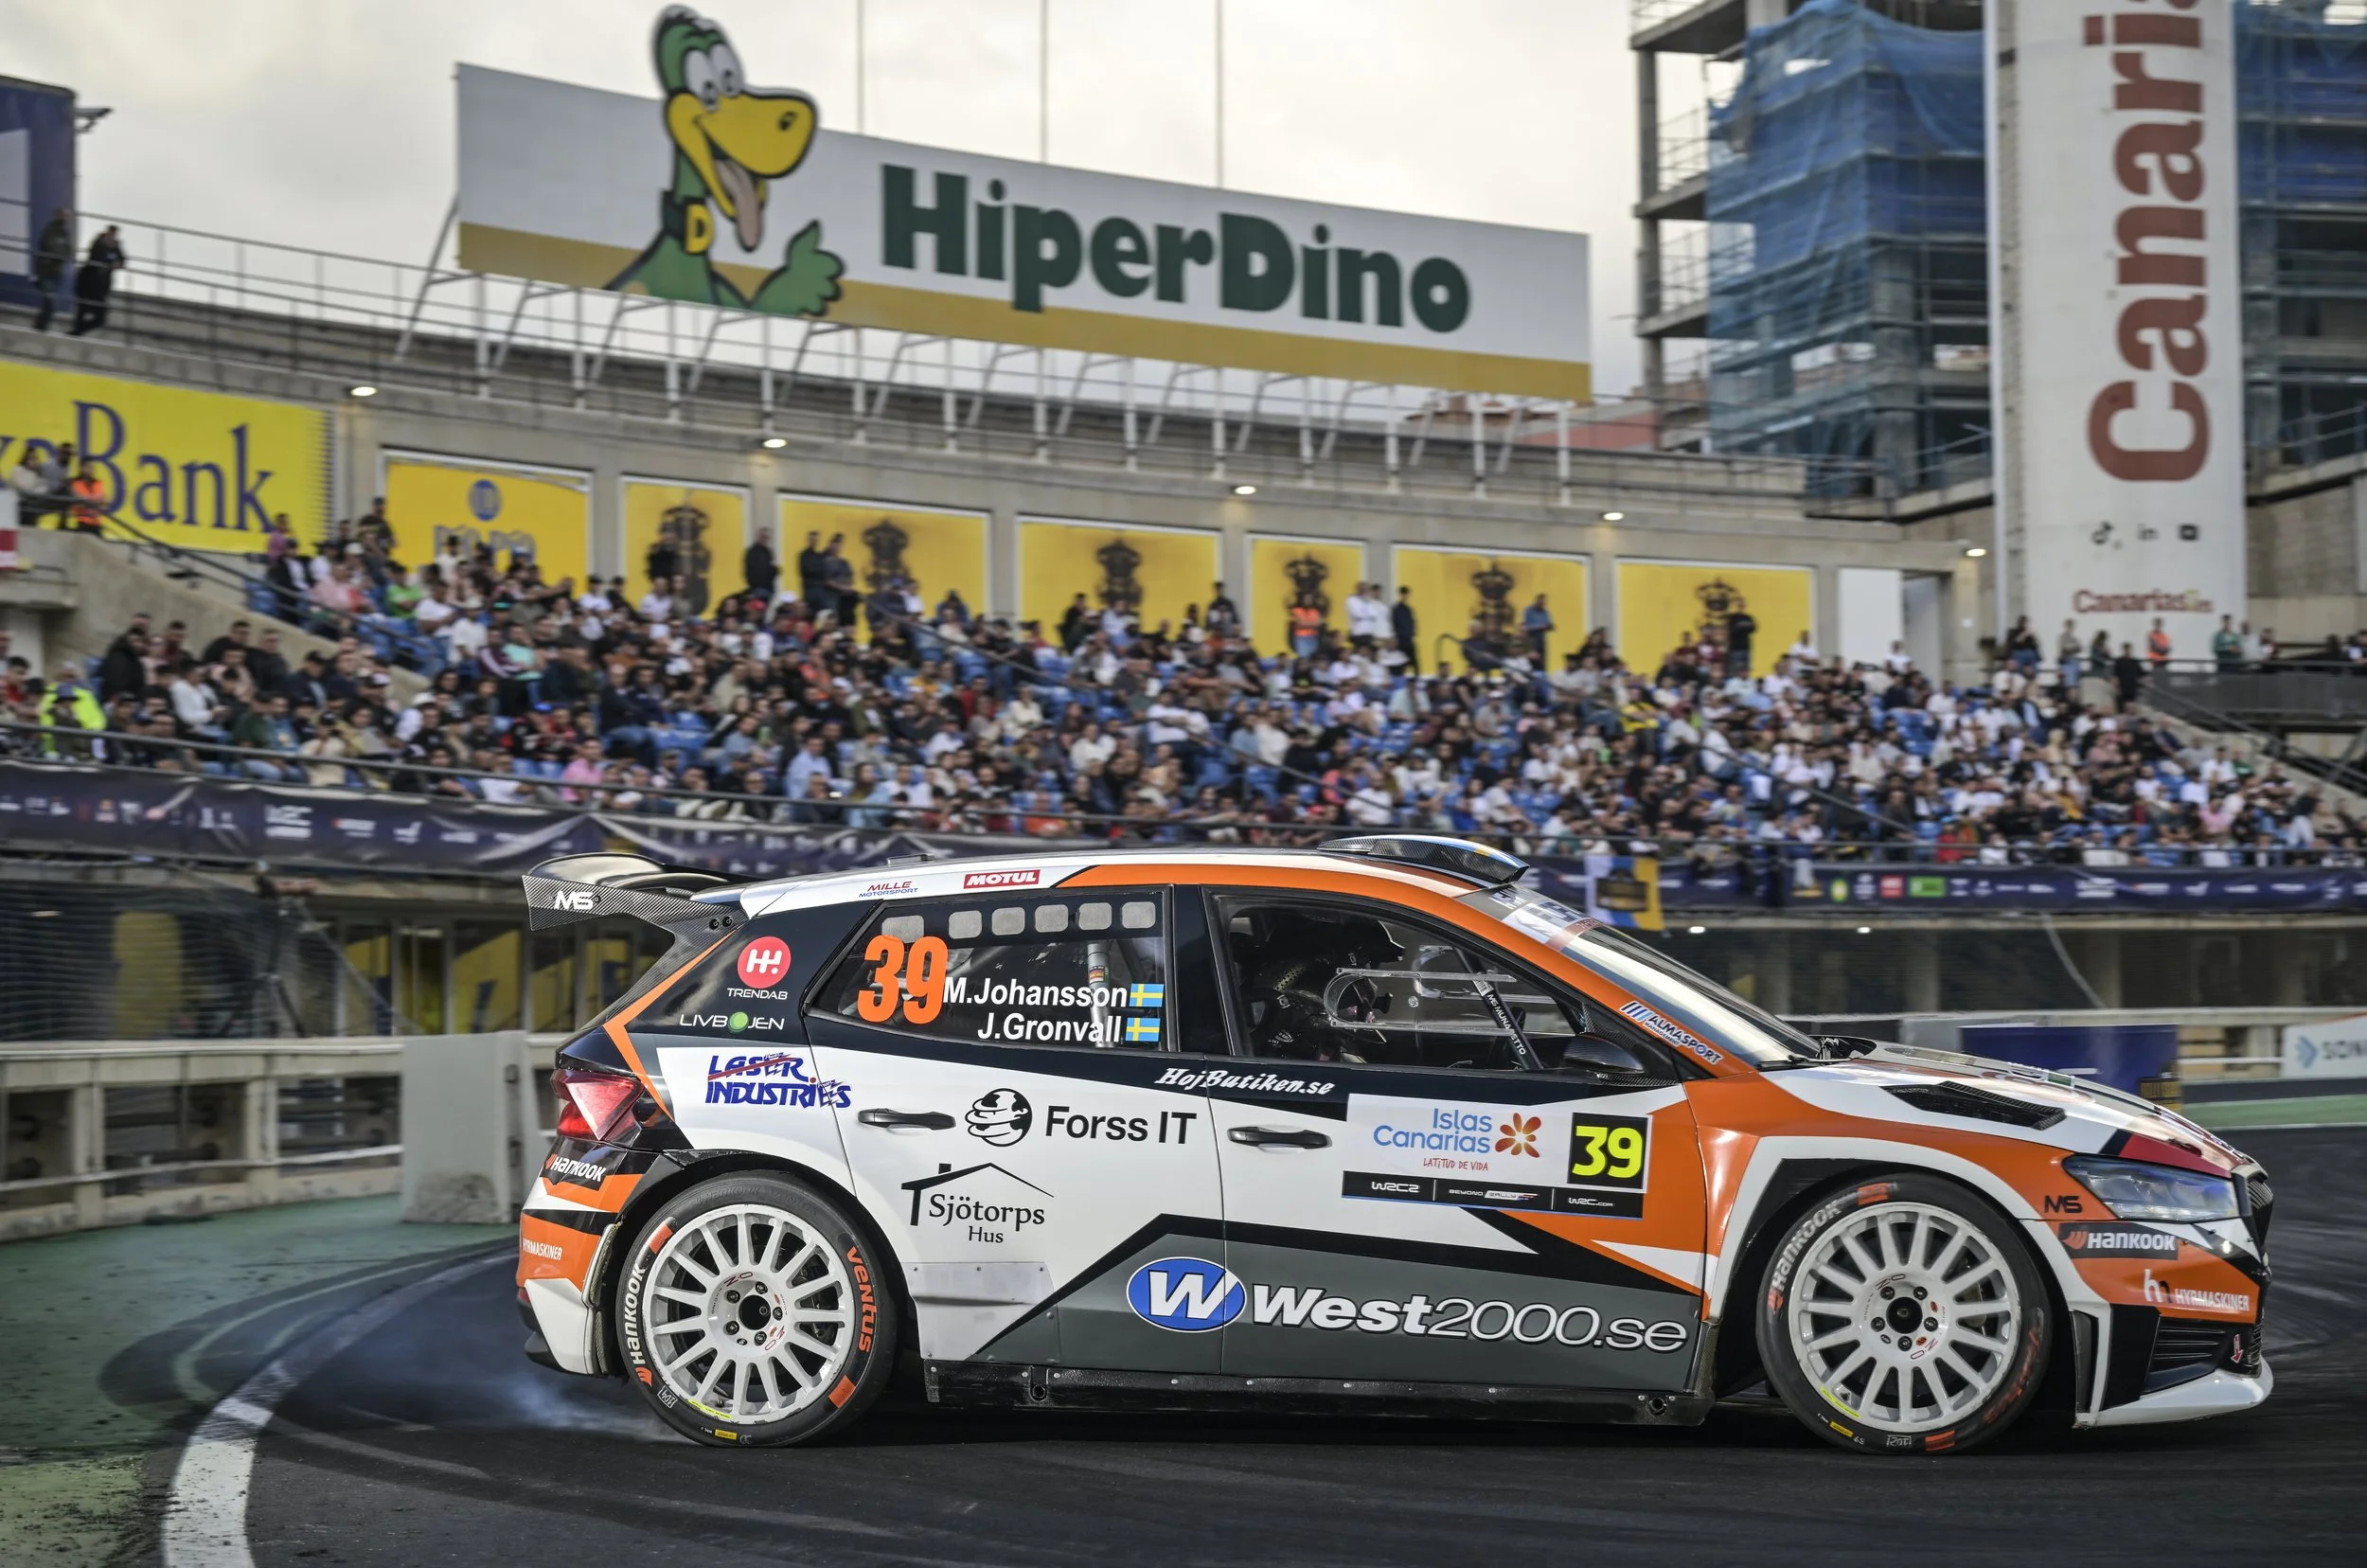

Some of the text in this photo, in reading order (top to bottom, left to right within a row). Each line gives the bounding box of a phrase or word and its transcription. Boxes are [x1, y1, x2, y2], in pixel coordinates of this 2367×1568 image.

[881, 162, 1471, 333] HiperDino
[2080, 0, 2211, 482] Canari
[859, 887, 918, 898] MOTORSPORT
[867, 881, 913, 892] MILLE
[967, 871, 1038, 886] MOTUL
[553, 890, 594, 910] MS
[726, 988, 788, 1000] TRENDAB
[857, 935, 949, 1025] 39
[942, 977, 1128, 1007] M.Johansson
[977, 1012, 1122, 1042] J.Gronvall
[1647, 1015, 1721, 1063] ALMASPORT
[707, 1055, 810, 1083] LASER
[704, 1081, 851, 1109] INDUSTRIES
[1045, 1105, 1197, 1145] Forss IT
[1433, 1108, 1493, 1132] Islas
[1373, 1124, 1491, 1154] Canarias
[1572, 1125, 1644, 1179] 39
[1458, 1161, 1468, 1170] DE
[1371, 1181, 1420, 1193] WRC2
[1449, 1188, 1484, 1197] BEYOND
[929, 1193, 1045, 1232] Sjötorps
[2044, 1195, 2083, 1214] MS
[968, 1225, 1005, 1244] Hus
[1148, 1270, 1237, 1320] W
[2174, 1289, 2251, 1312] HYRMASKINER
[1253, 1283, 1688, 1352] West2000.se
